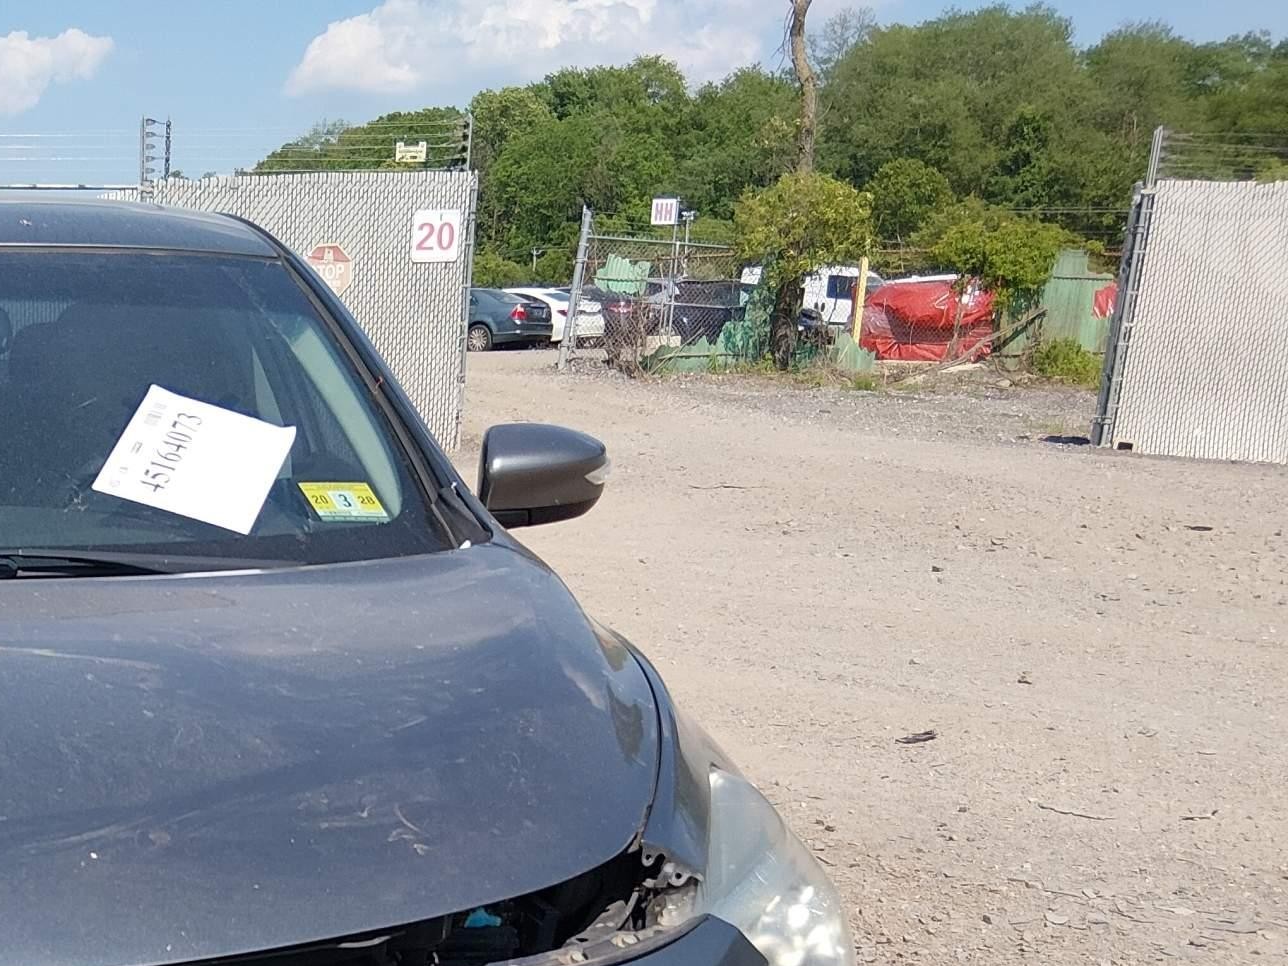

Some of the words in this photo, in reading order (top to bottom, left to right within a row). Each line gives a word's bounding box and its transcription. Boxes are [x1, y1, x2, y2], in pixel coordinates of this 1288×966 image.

[416, 222, 455, 251] 20
[313, 263, 345, 280] TOP
[140, 412, 203, 493] 45164073
[338, 493, 352, 508] 3
